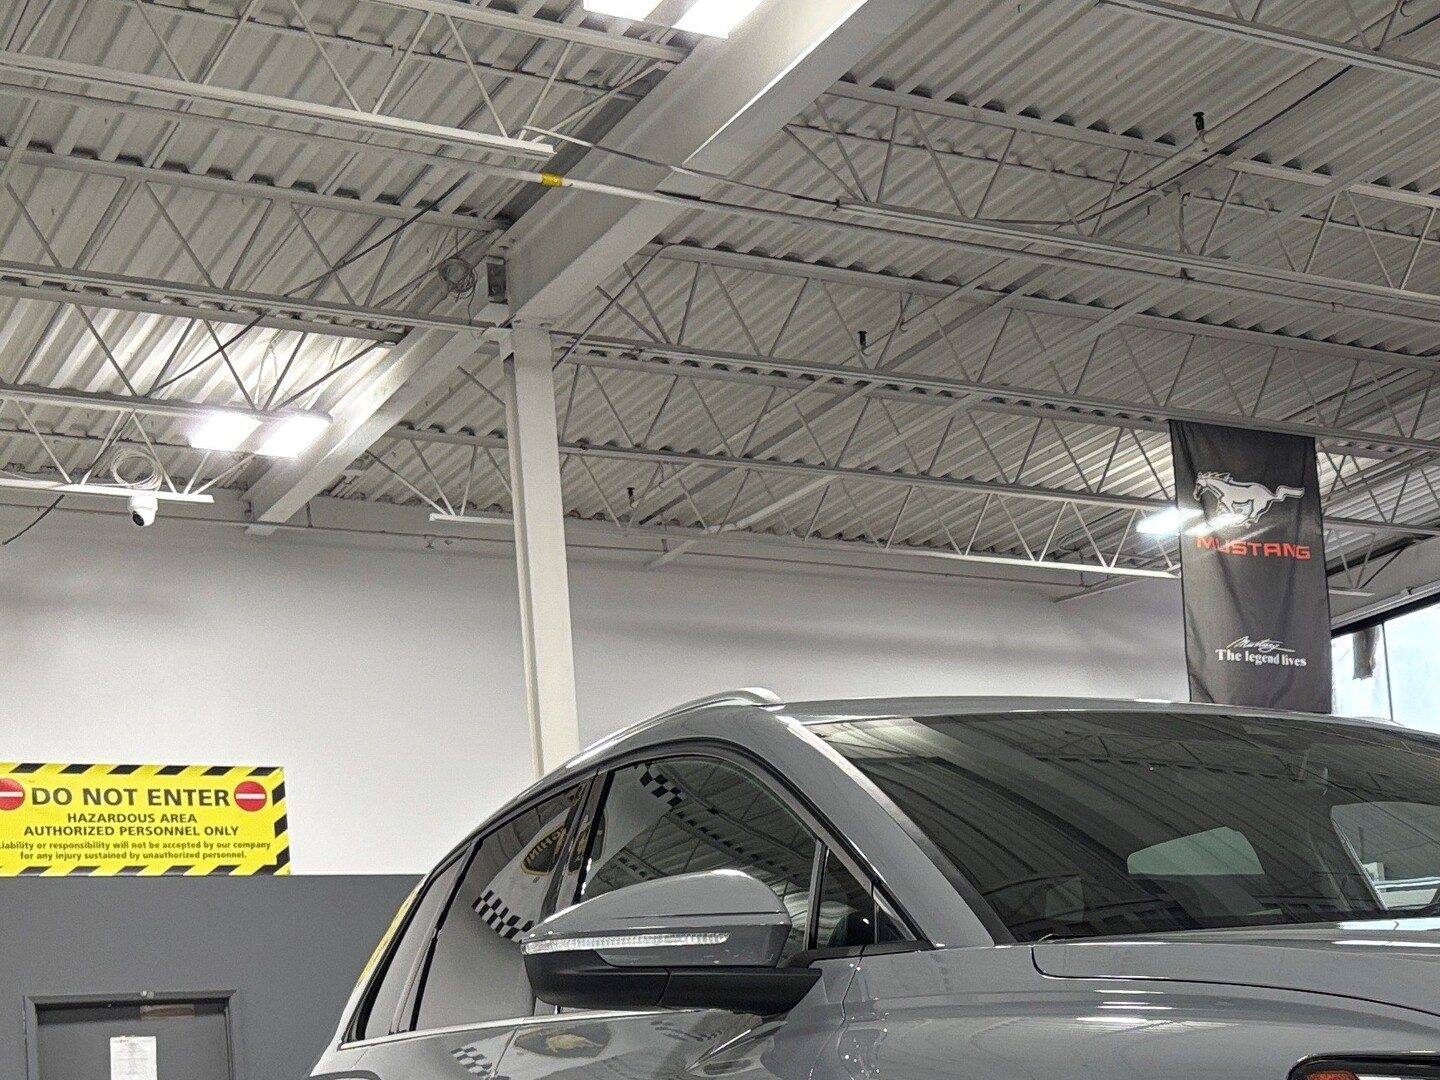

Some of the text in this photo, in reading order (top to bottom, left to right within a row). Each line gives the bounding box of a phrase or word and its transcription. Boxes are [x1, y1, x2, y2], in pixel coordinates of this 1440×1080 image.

[1196, 534, 1311, 560] MUSTANG
[1215, 649, 1307, 667] The legend lives
[31, 787, 231, 807] DO NOT ENTER
[67, 813, 198, 824] HAZARDOUS AREA
[23, 826, 239, 836] AUTHORIZED PERSONNEL ONLY
[49, 841, 110, 851] responsibility
[113, 841, 129, 849] will
[149, 841, 160, 849] be
[162, 841, 201, 850] accepted
[203, 841, 214, 850] by
[233, 843, 271, 851] company
[20, 851, 247, 861] for any injury sustained by unauthorized personnel.
